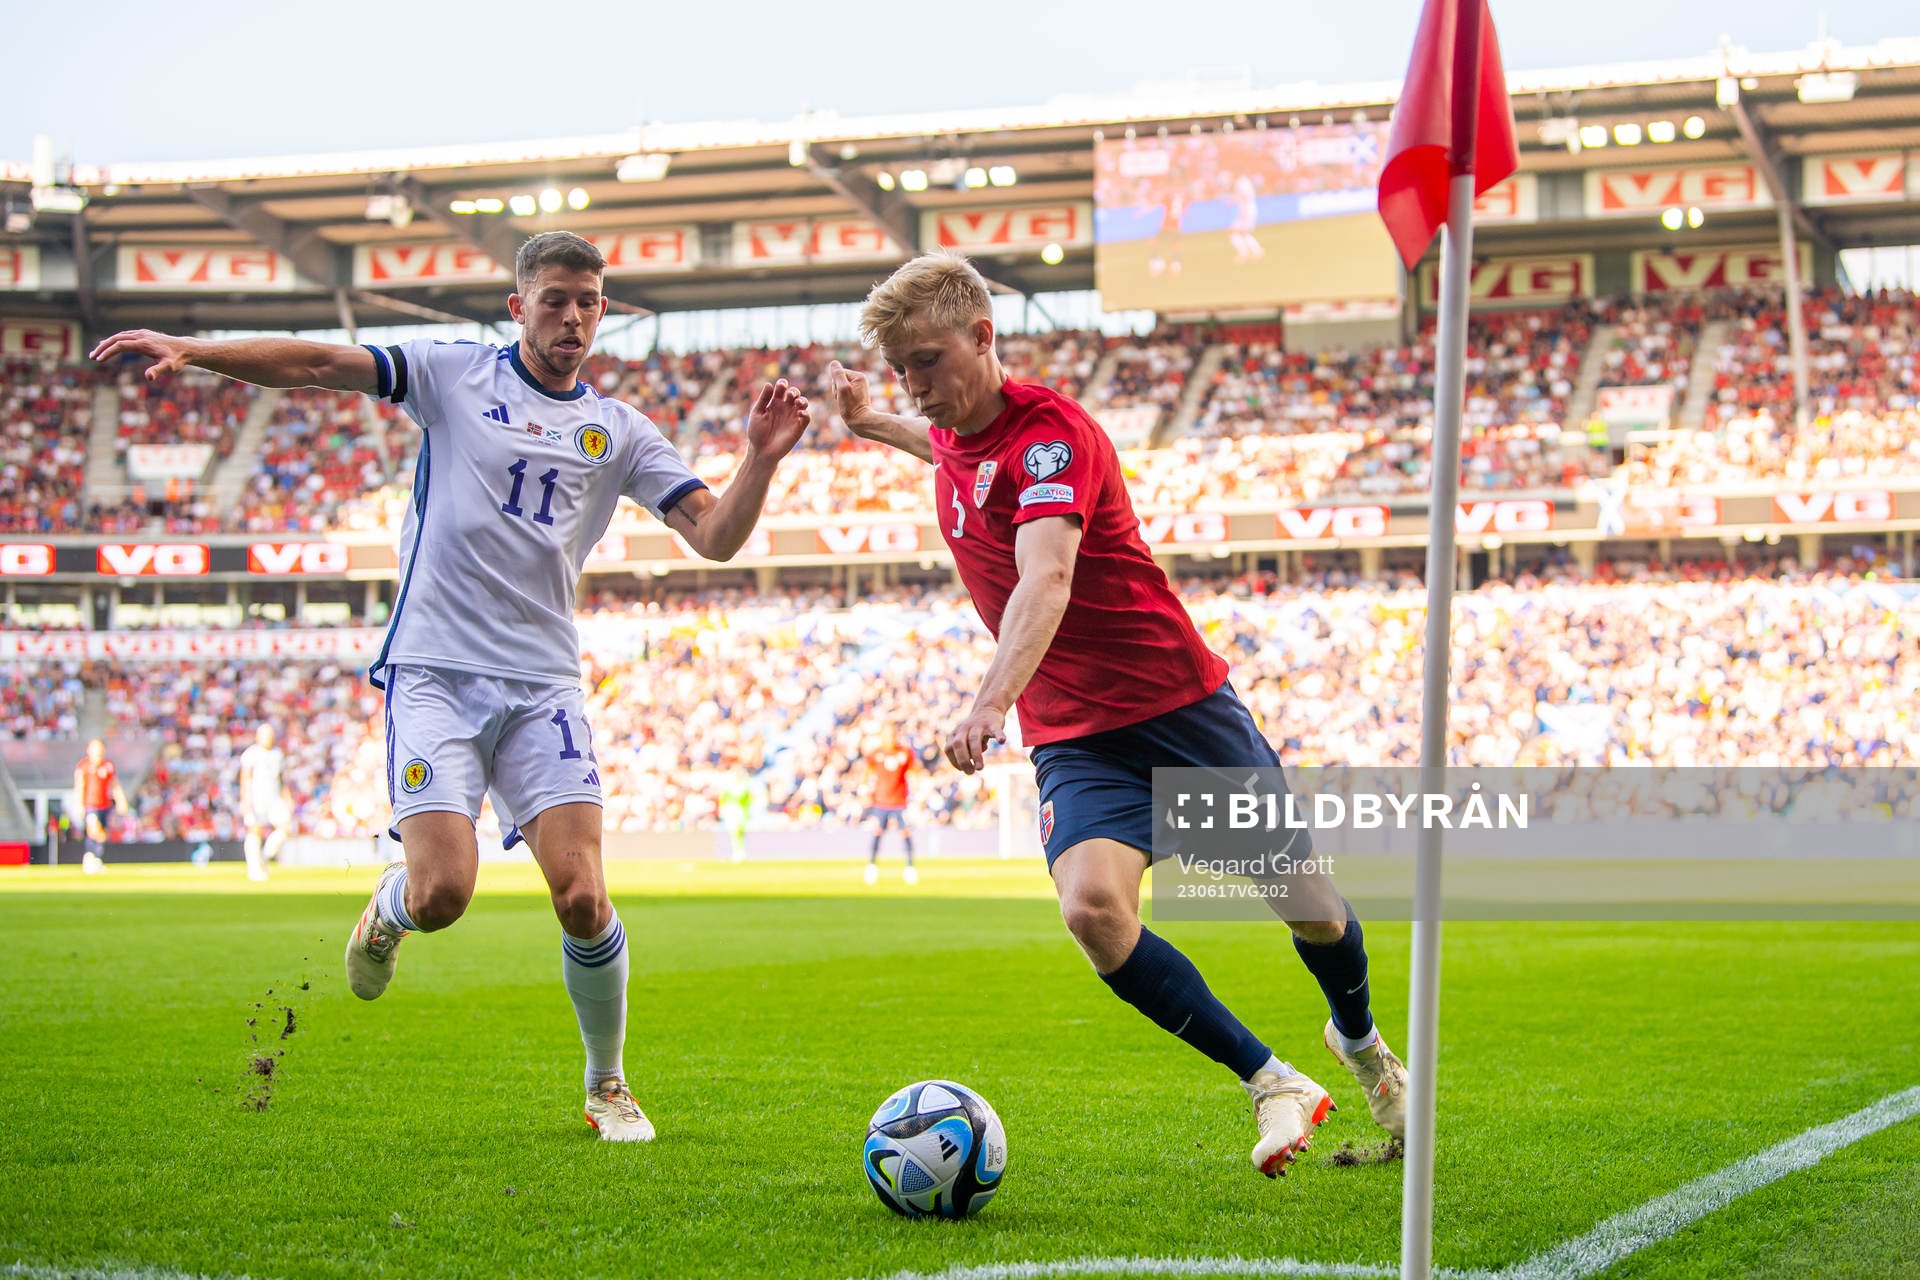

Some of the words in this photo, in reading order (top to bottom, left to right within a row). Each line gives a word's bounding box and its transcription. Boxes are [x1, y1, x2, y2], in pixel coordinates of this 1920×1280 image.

[1603, 166, 1753, 208] VG
[1825, 158, 1920, 194] V
[752, 223, 884, 257] VG
[938, 208, 1075, 246] VG
[138, 249, 275, 282] VG
[371, 246, 495, 279] VG
[1646, 253, 1793, 291] VG
[502, 459, 559, 526] 11
[1776, 493, 1890, 522] VG
[1141, 513, 1226, 543] VG
[1278, 506, 1386, 539] VG
[1455, 501, 1550, 533] VG
[818, 527, 918, 554] VG
[101, 544, 206, 575] VG
[251, 543, 348, 573] VG
